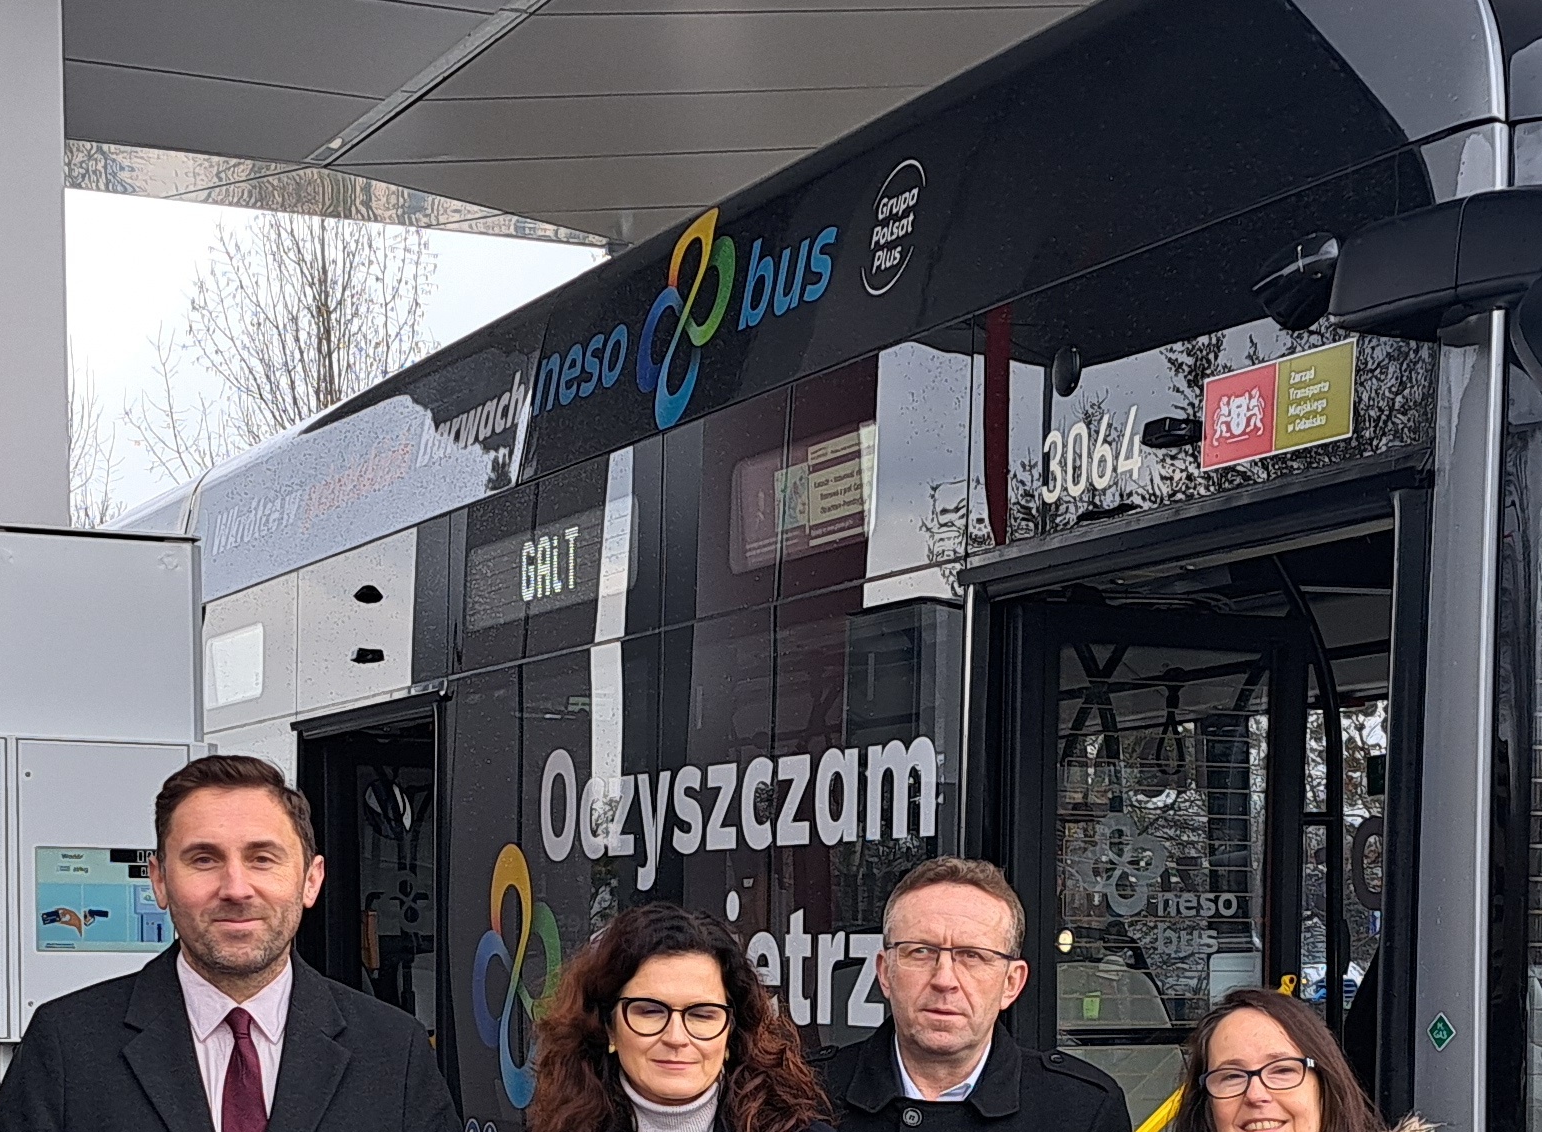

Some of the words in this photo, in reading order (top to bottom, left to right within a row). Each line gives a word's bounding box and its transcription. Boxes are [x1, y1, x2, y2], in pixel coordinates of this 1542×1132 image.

[877, 186, 920, 221] Grupa
[870, 210, 915, 251] Polsat
[871, 246, 902, 275] Plus
[532, 323, 628, 416] neso
[737, 226, 838, 331] bus
[1042, 405, 1143, 503] 3064
[540, 736, 938, 891] Oczyszczam
[1158, 892, 1238, 917] neso
[1159, 922, 1220, 954] bus
